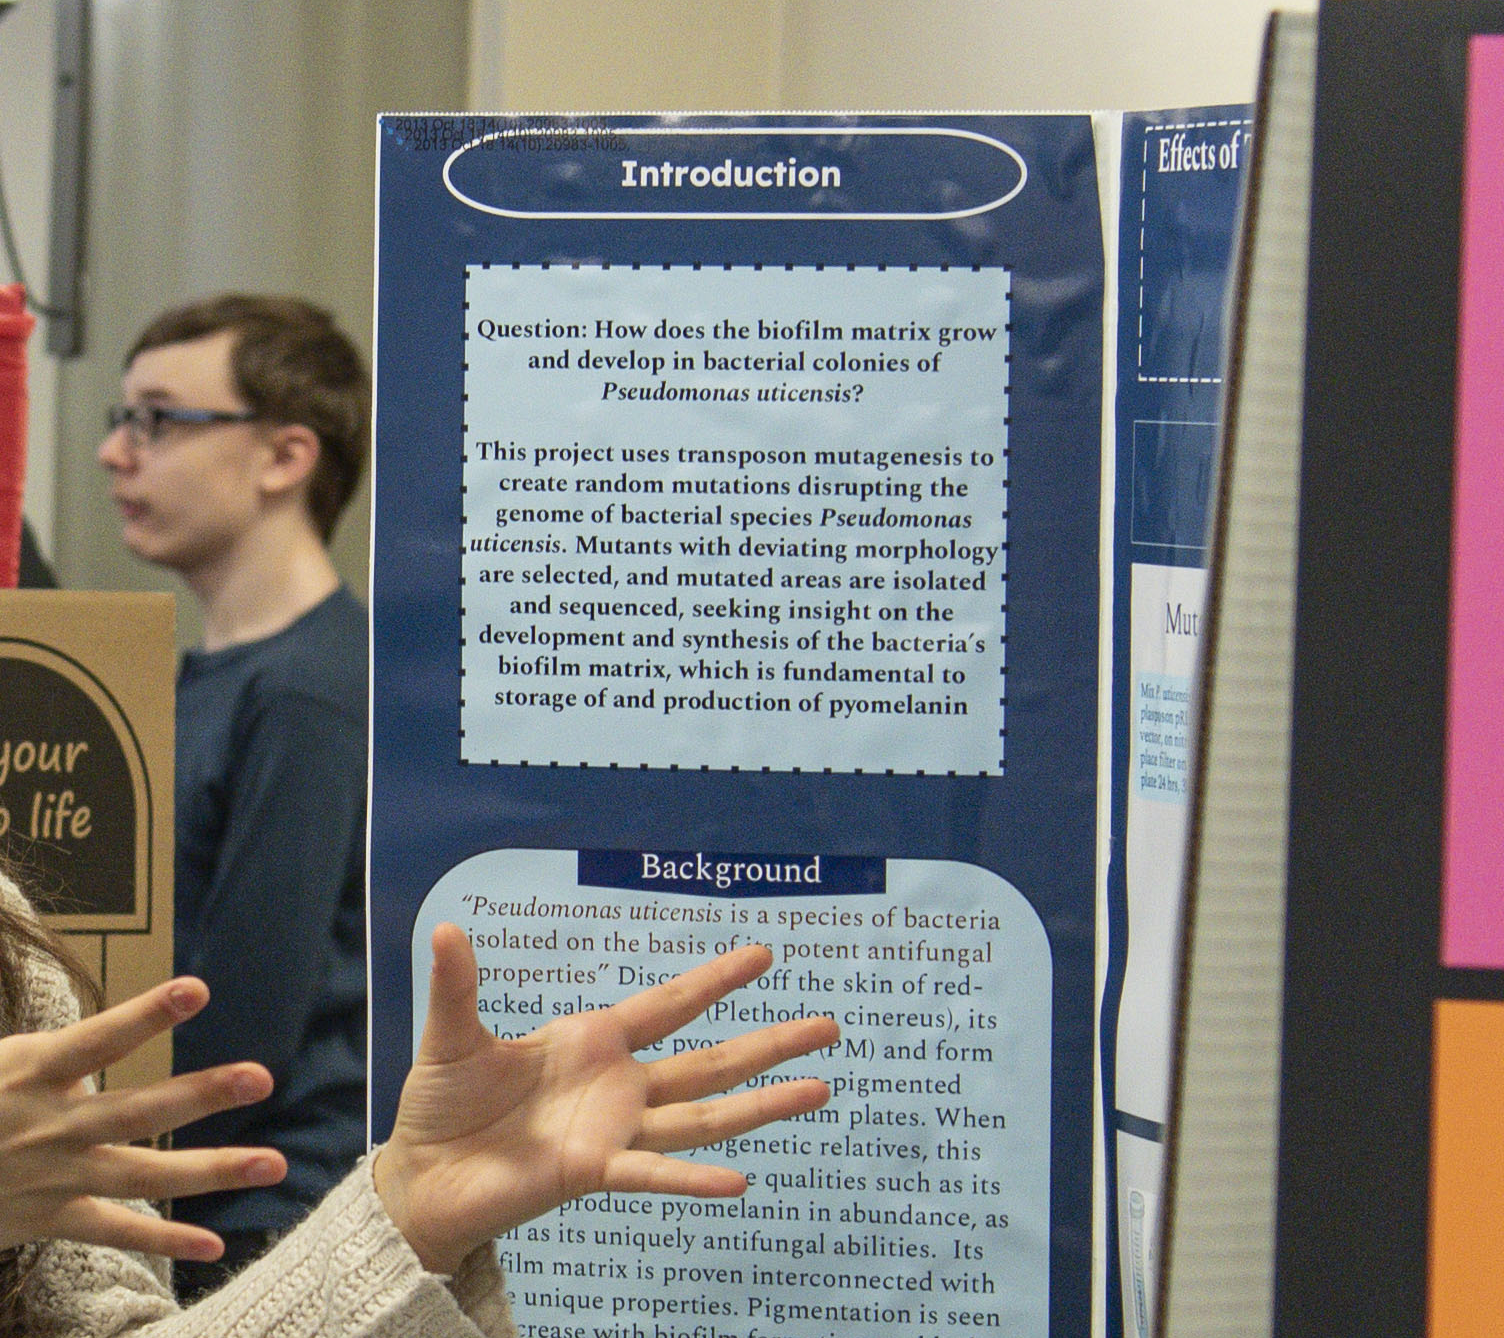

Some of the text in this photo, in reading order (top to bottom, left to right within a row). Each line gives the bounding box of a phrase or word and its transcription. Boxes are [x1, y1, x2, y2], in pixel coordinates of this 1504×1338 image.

[1158, 128, 1241, 173] Effects of
[621, 157, 841, 188] Introduction
[477, 318, 997, 347] Question: How does the biofilm matrix grow
[528, 348, 943, 376] and develop in bacterial colonies of
[601, 380, 864, 403] Pseudomonas uticensis?
[475, 440, 994, 471] This project uses transposon mutagenesis to
[498, 472, 968, 502] create random mutations disrupting the
[496, 502, 972, 532] genome of bacterial species Pseudomonas
[30, 790, 93, 840] life
[642, 853, 821, 888] Background
[629, 905, 722, 923] uticensis
[731, 910, 749, 923] is
[757, 910, 769, 924] a
[778, 911, 863, 930] species
[871, 905, 898, 928] of
[903, 906, 1001, 931] bacteria
